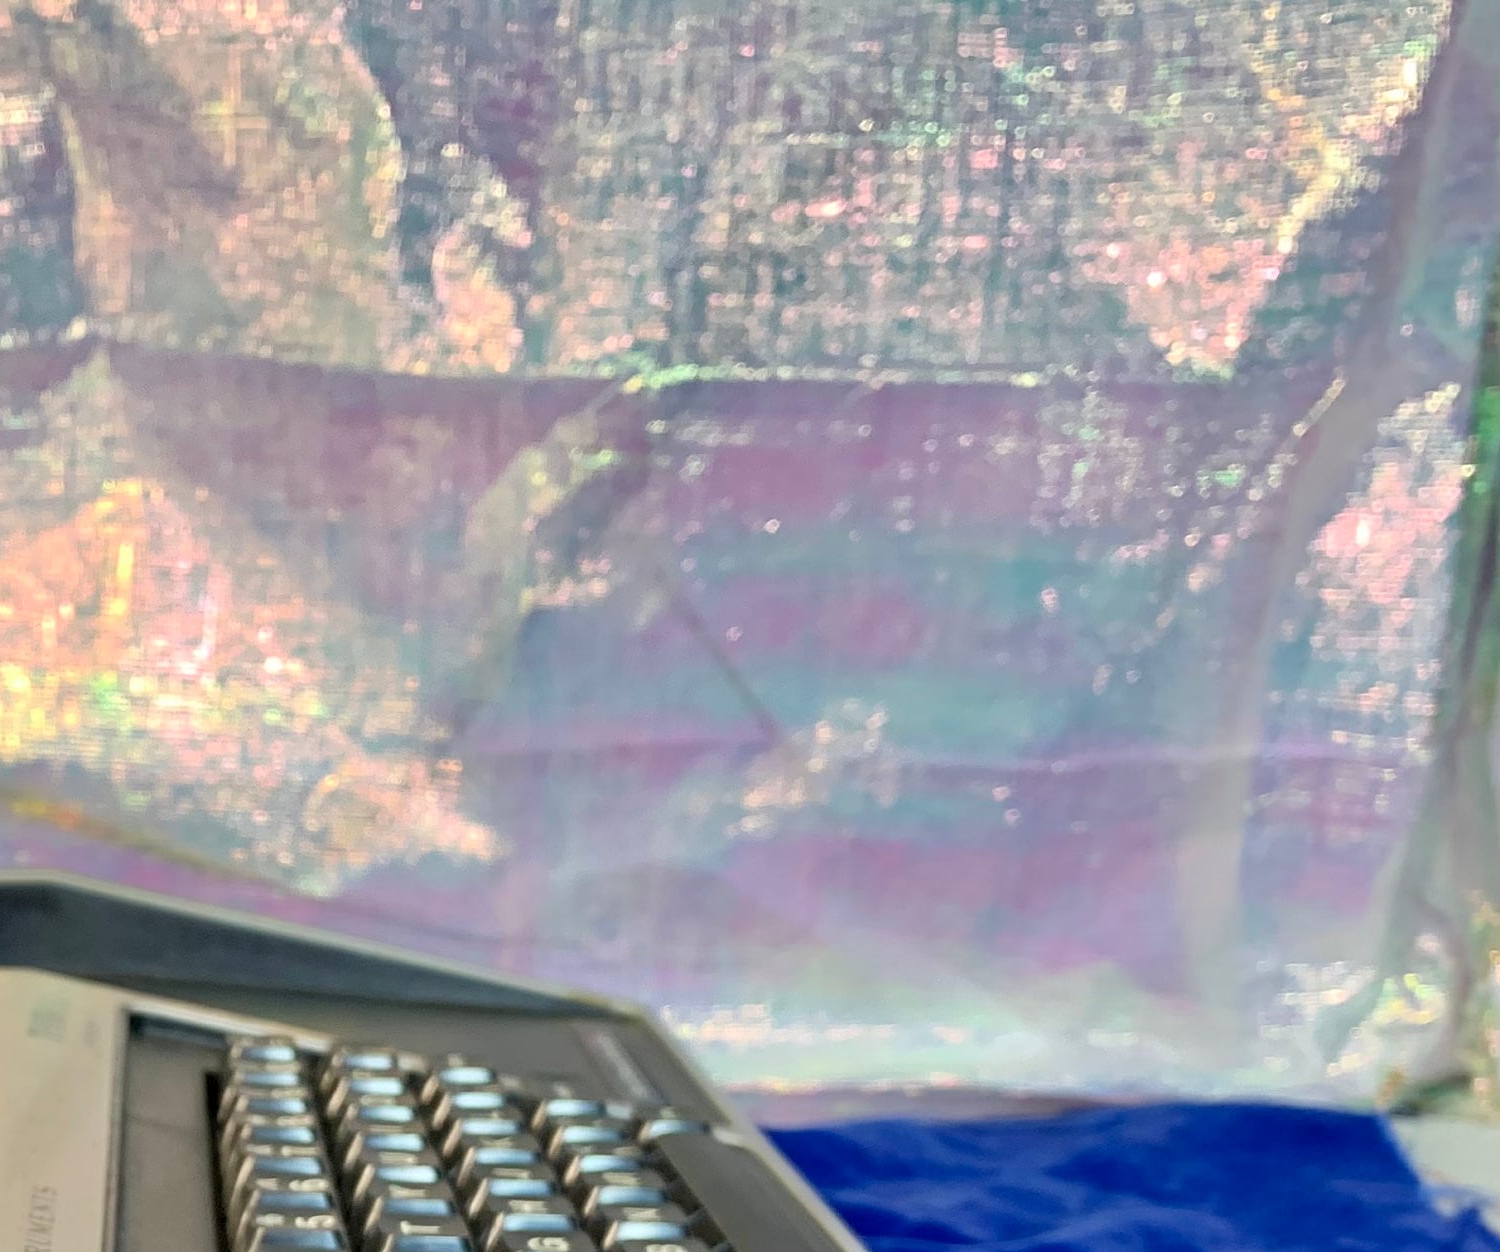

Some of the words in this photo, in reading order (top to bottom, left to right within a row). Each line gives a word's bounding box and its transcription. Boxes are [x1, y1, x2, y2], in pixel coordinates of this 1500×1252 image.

[289, 1178, 329, 1192] 6
[295, 1215, 336, 1229] 5
[400, 1221, 441, 1235] T
[527, 1237, 570, 1252] G
